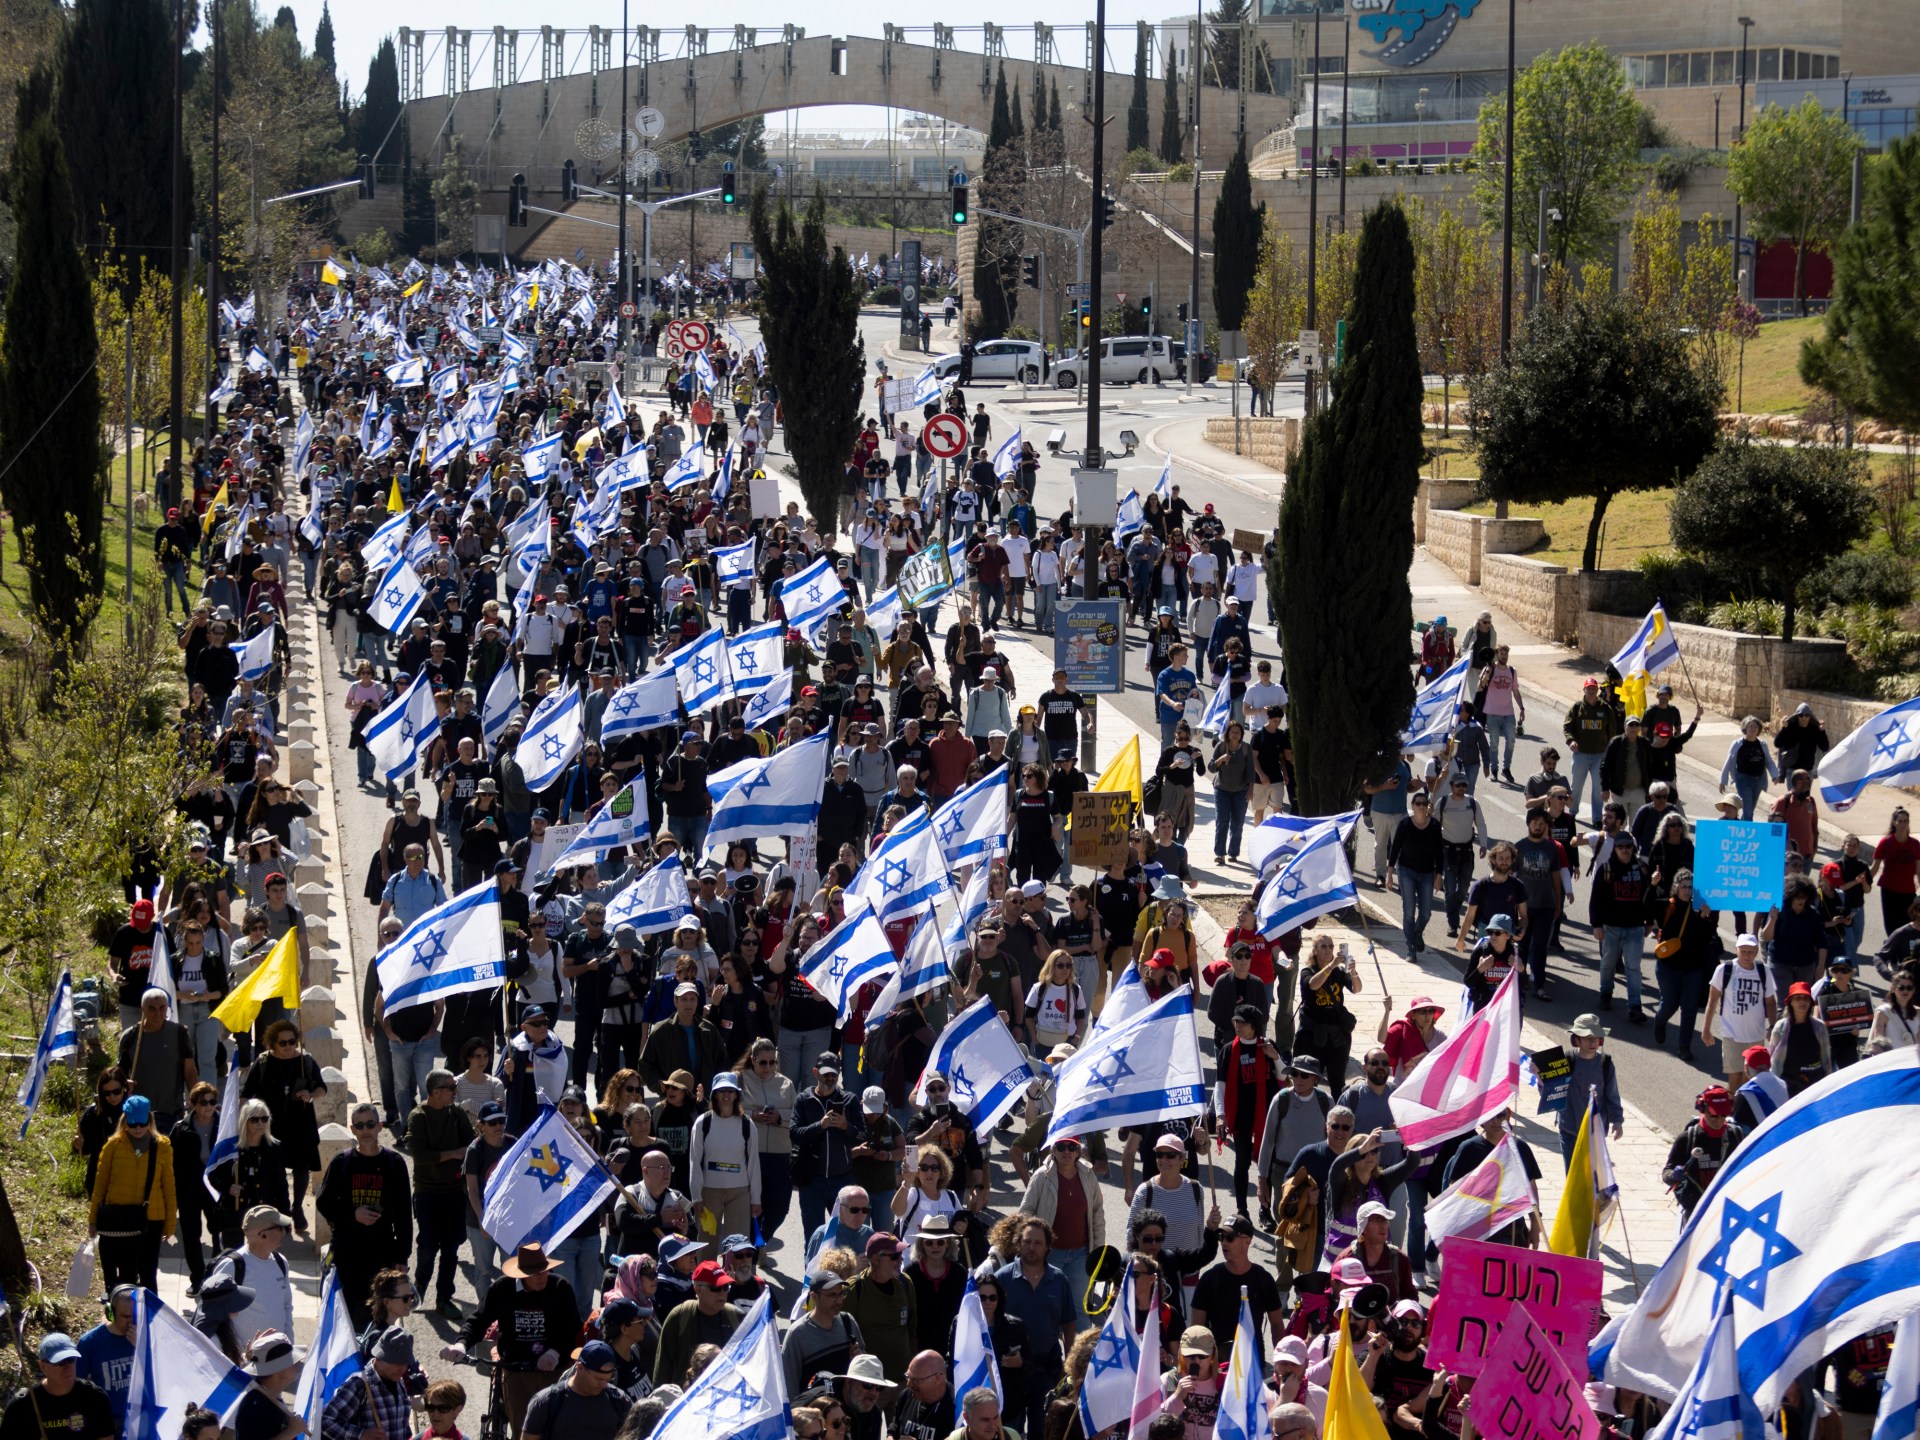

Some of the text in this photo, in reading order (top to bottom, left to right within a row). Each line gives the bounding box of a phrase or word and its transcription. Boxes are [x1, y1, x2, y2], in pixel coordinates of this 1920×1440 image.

[1728, 826, 1756, 839] ניגוד
[1737, 978, 1761, 991] דמו
[1737, 990, 1760, 1006] קרט
[1046, 1000, 1053, 1010] I
[1166, 1087, 1192, 1097] חופשי
[1167, 1095, 1194, 1107] בארצנו
[1483, 1257, 1561, 1307] העם
